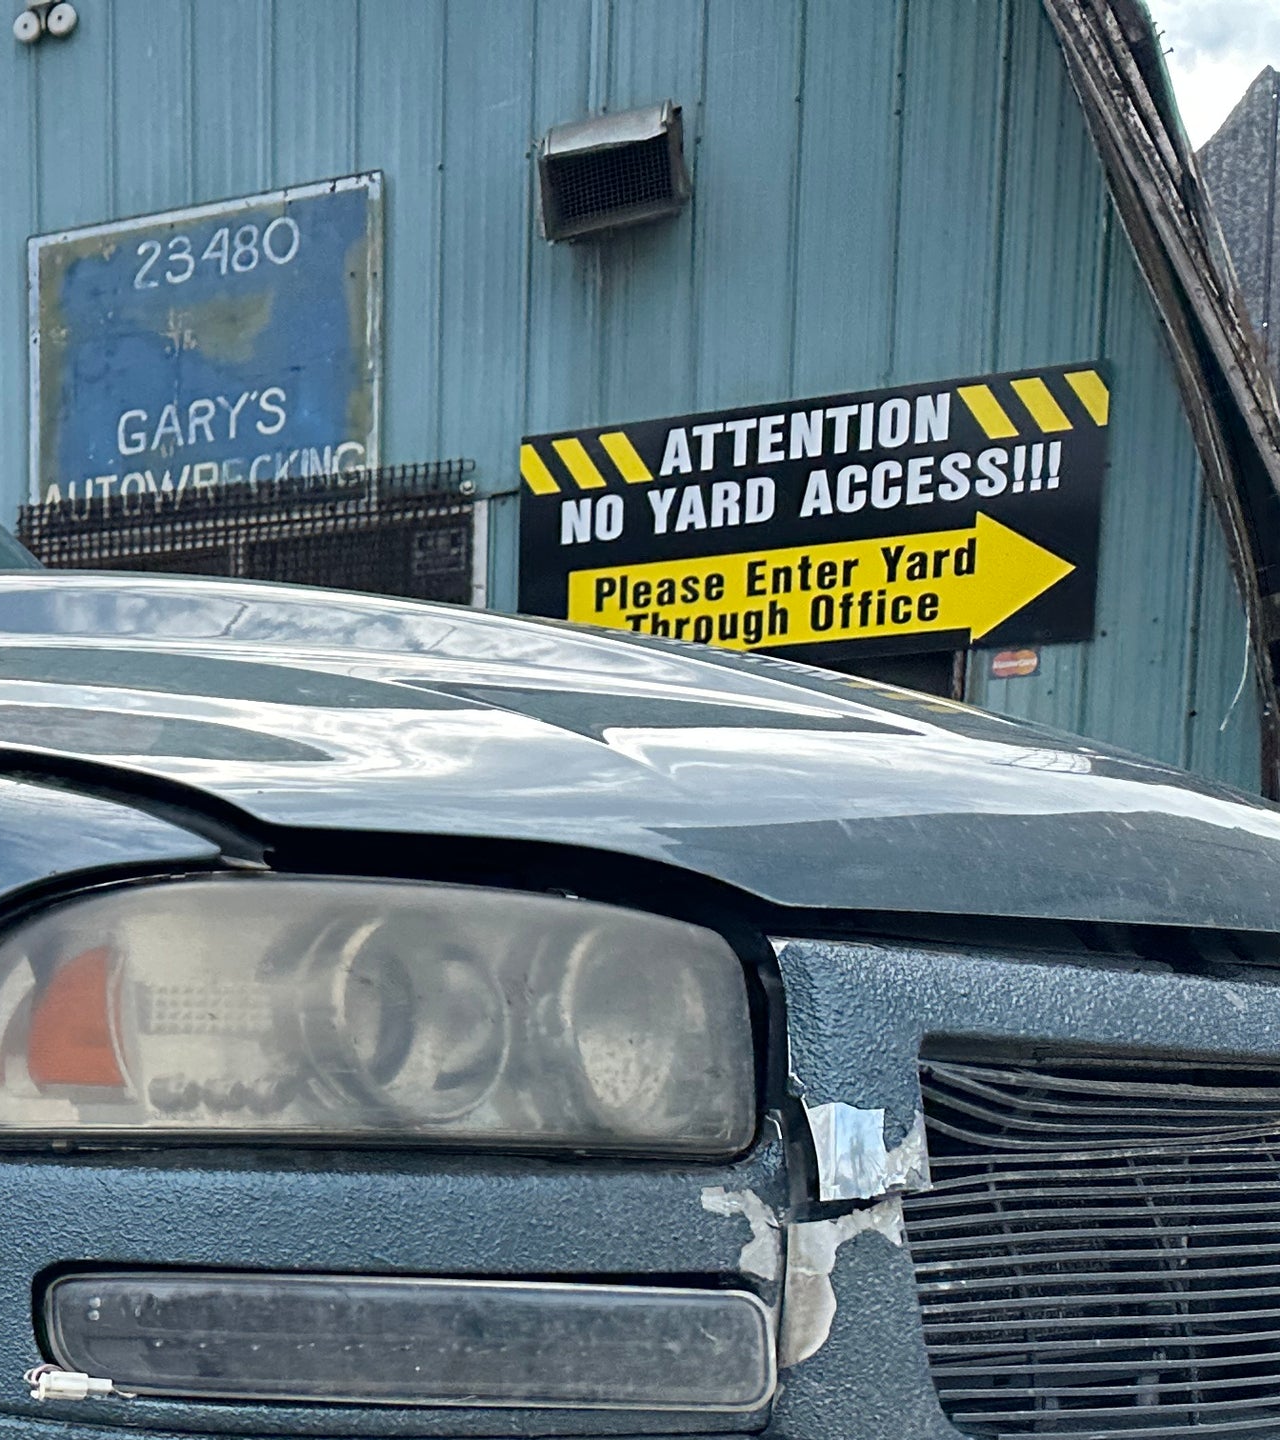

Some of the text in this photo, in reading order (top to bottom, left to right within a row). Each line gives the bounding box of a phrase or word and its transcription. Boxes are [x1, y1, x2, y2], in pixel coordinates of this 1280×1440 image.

[134, 217, 300, 289] 23480
[117, 387, 286, 455] GARY'S
[659, 392, 952, 476] ATTENTION
[560, 441, 1063, 546] NO YARD ACCESS!!!
[594, 538, 977, 613] Please Enter Yard
[625, 590, 940, 645] Through Office
